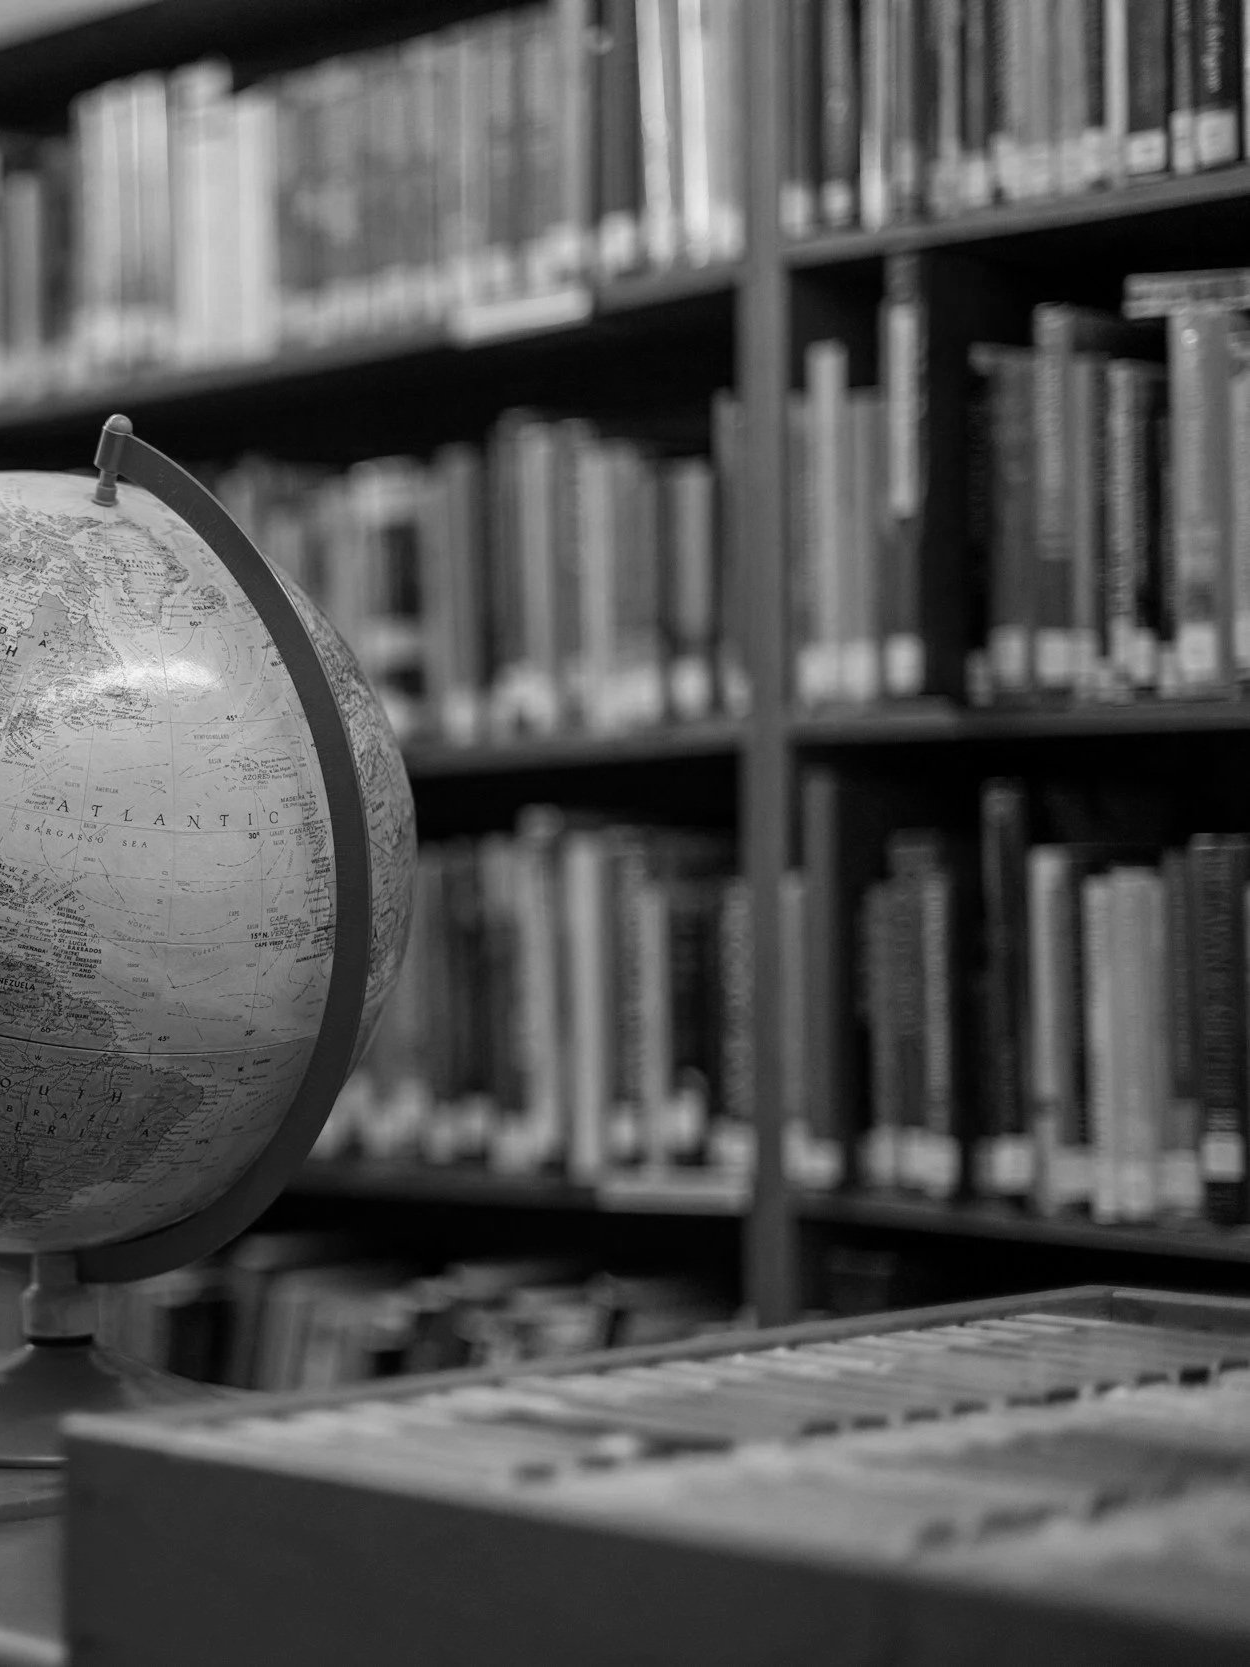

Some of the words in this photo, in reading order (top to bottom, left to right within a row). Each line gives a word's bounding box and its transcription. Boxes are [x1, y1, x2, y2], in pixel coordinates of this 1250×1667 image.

[225, 714, 238, 722] 45°
[243, 772, 270, 780] AZORES
[56, 800, 279, 831] ATLANTIC
[289, 826, 314, 835] CANARY
[24, 823, 104, 844] SARGASSO
[121, 839, 149, 848] SEA
[248, 831, 261, 840] 30°
[269, 915, 288, 923] CAPE
[58, 927, 88, 937] DOMINICA
[271, 929, 294, 938] VERDE
[67, 945, 102, 954] BARBADOS
[272, 943, 301, 952] ISLANDS
[157, 1034, 171, 1042] 45°
